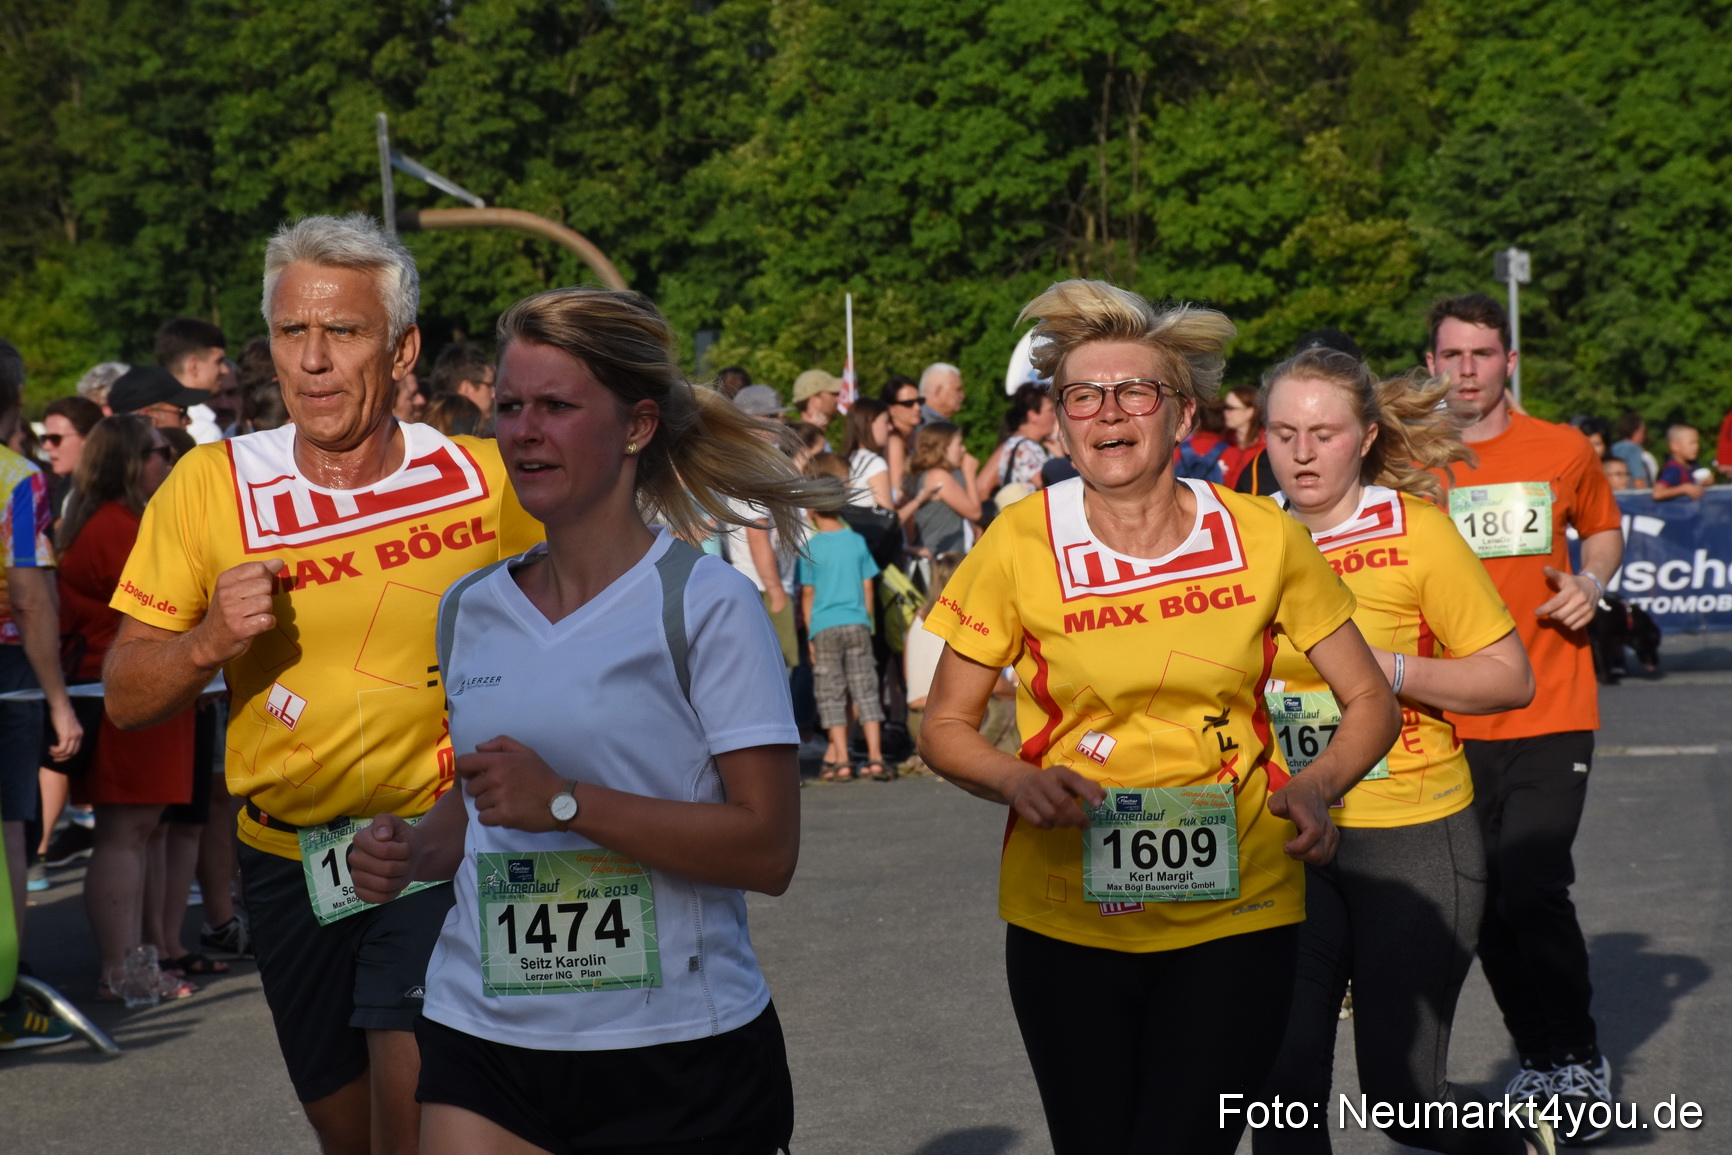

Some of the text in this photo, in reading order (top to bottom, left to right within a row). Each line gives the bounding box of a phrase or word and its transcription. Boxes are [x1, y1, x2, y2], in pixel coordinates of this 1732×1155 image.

[375, 516, 496, 570] BÖGL
[119, 580, 177, 615] -boegl.de
[1630, 594, 1732, 614] TOMOB
[1064, 584, 1256, 634] MAX BÖGL
[467, 676, 502, 685] LERZER
[1278, 709, 1320, 719] firmenlauf
[1278, 725, 1339, 757] 167
[1286, 759, 1313, 767] Schröd
[1105, 810, 1166, 821] firmenlauf
[1201, 815, 1226, 825] 2019
[320, 820, 373, 843] firmenlau
[1103, 827, 1217, 869] 1609
[1130, 871, 1194, 883] Kerl Margit
[342, 886, 354, 896] Sc
[499, 879, 560, 893] firmenlauf
[604, 884, 639, 898] 2019
[1125, 883, 1143, 892] Bögl
[1146, 882, 1189, 891] Bauservice
[1191, 881, 1215, 889] GmbH
[333, 901, 346, 909] Max
[347, 895, 360, 905] Bög
[498, 898, 631, 954] 1474
[520, 954, 606, 970] Seitz Karolin
[525, 969, 602, 981] Lerzer ING Plan
